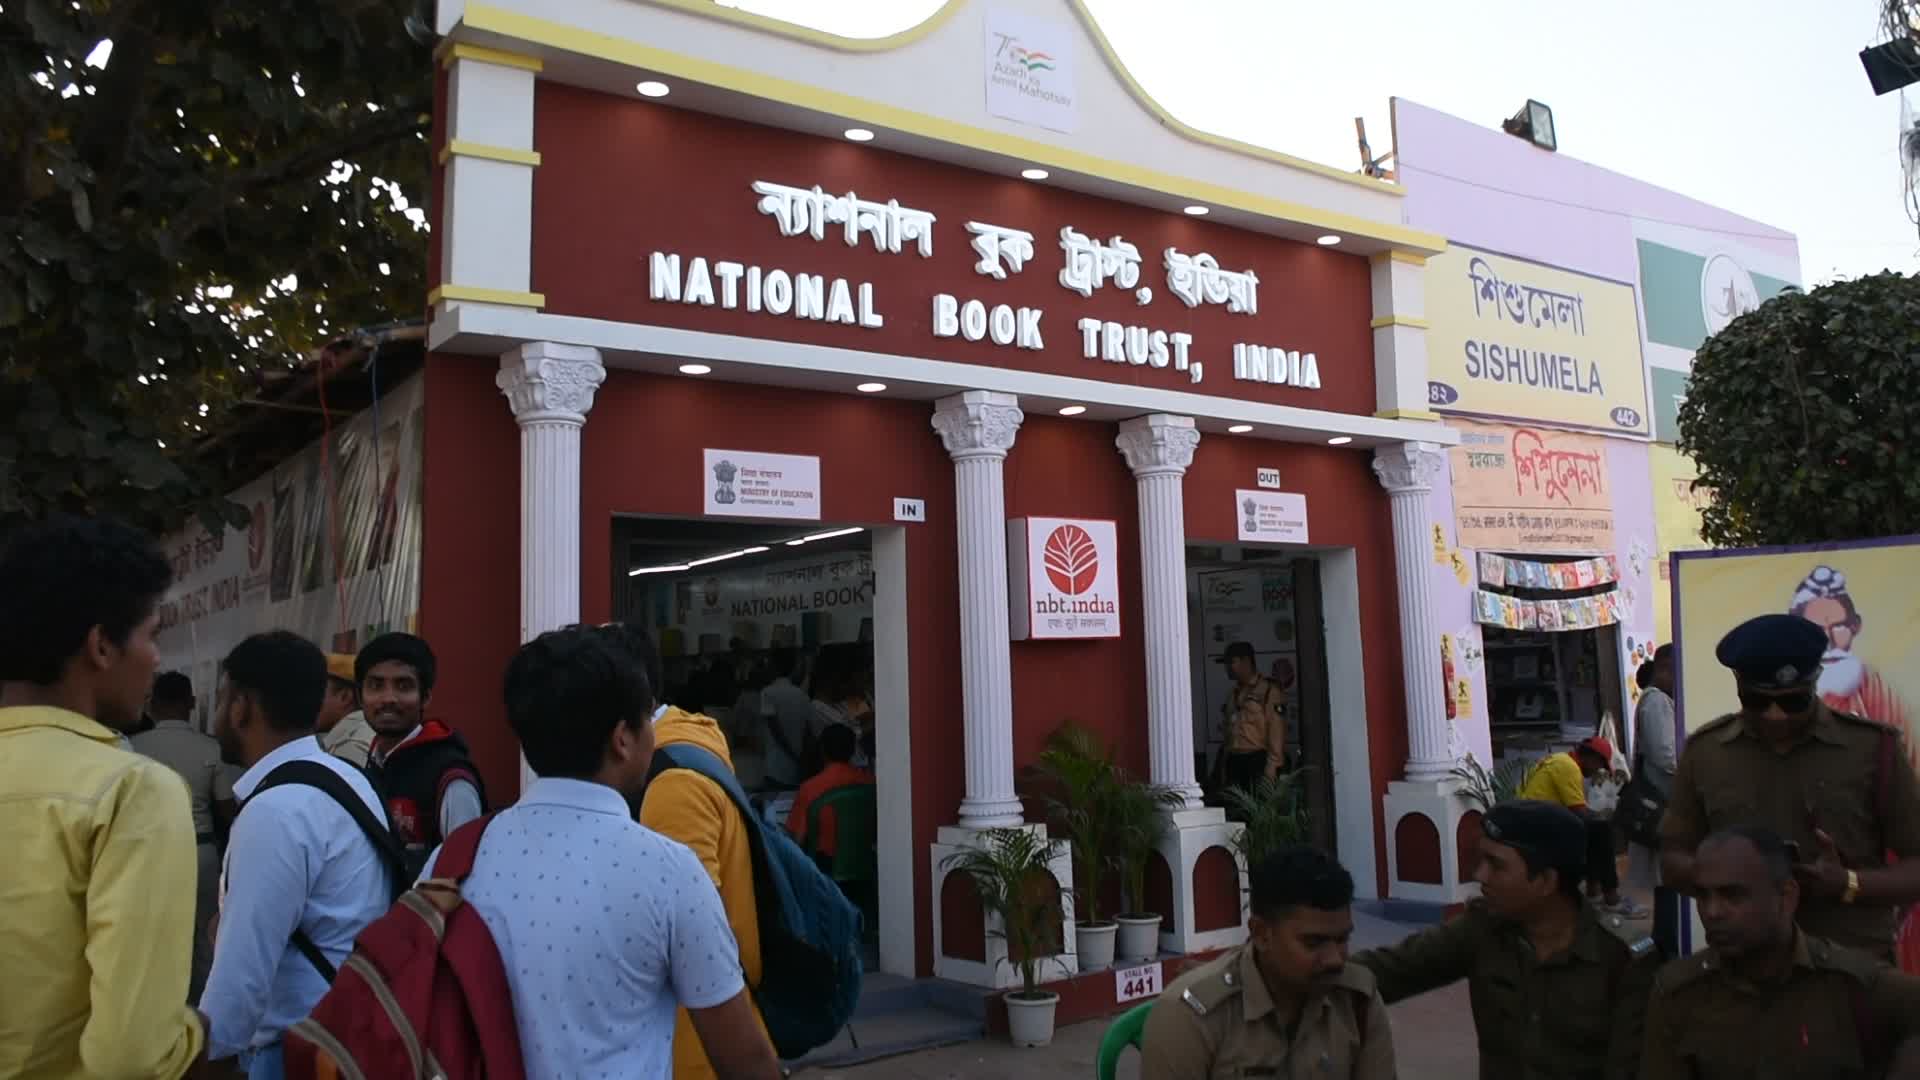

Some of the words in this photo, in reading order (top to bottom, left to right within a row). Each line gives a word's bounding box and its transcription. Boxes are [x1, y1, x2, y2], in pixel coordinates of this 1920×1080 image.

[751, 180, 936, 257] ন্যাশনাল
[965, 220, 1034, 280] বুক
[1467, 256, 1585, 337] শিশুমেলা
[649, 251, 884, 328] NATIONAL
[932, 293, 1045, 350] BOOK
[1078, 317, 1204, 384] TRUST,
[1233, 342, 1322, 389] INDIA
[1464, 339, 1604, 396] SISHUMELA
[1616, 408, 1637, 426] 442
[1258, 472, 1279, 485] OUT
[902, 503, 917, 517] IN
[730, 593, 809, 617] NATIONAL
[813, 585, 865, 609] BOOK
[1036, 592, 1116, 614] nbt.india
[1123, 976, 1154, 997] 441
